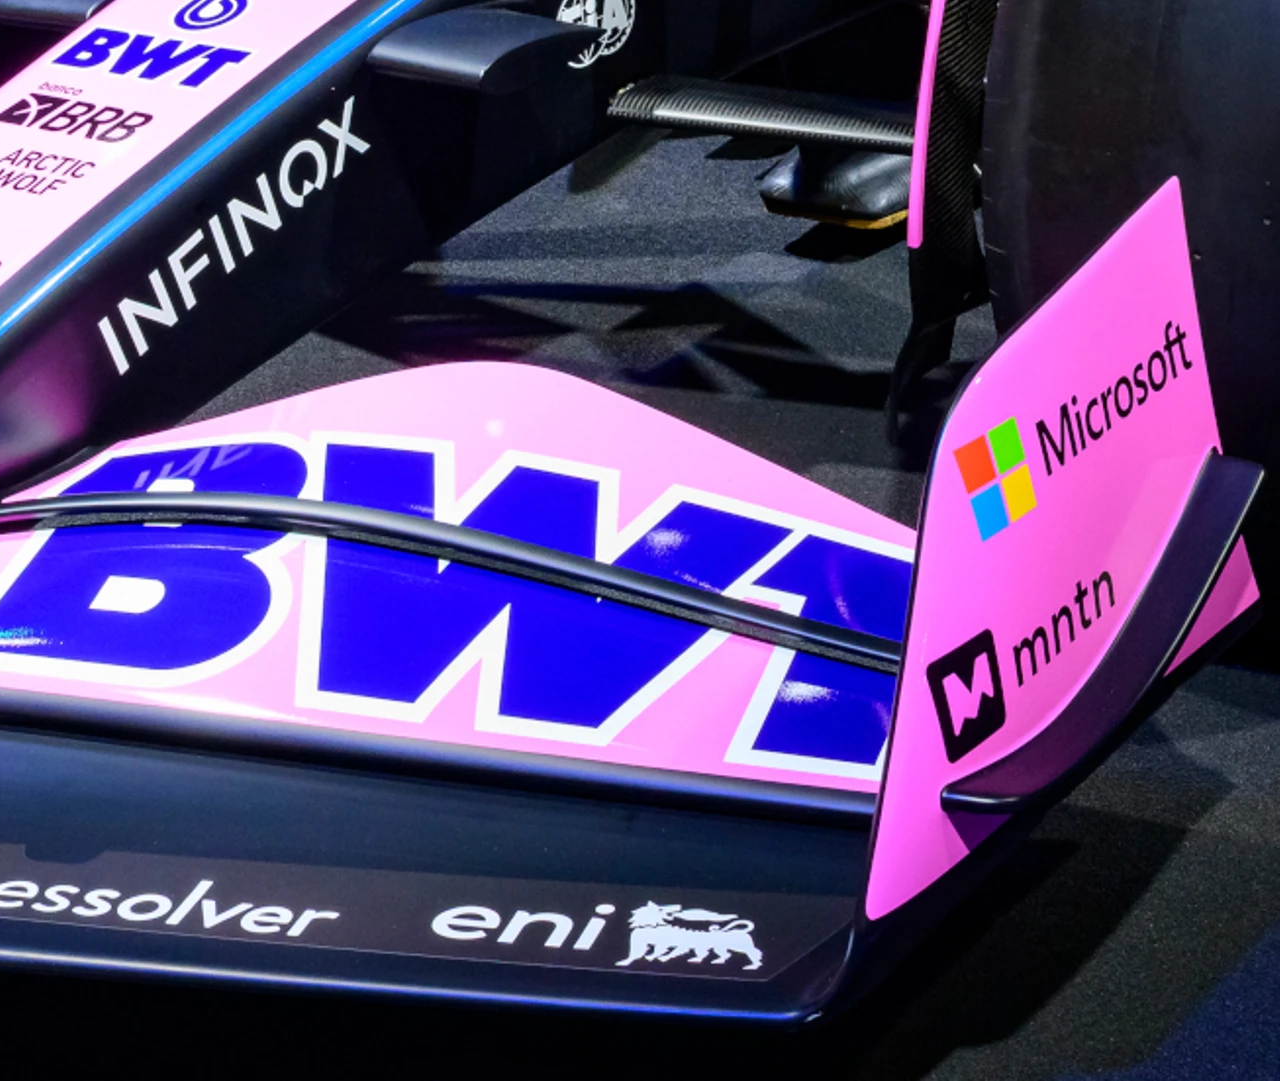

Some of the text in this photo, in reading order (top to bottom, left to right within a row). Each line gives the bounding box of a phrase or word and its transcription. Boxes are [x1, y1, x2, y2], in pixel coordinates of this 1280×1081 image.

[52, 27, 252, 88] BWT
[38, 81, 83, 97] banco
[38, 100, 154, 144] BRB
[96, 96, 371, 376] INFINOX
[1035, 320, 1193, 477] Microsoft
[1012, 570, 1116, 687] mntn
[430, 899, 616, 955] eni
